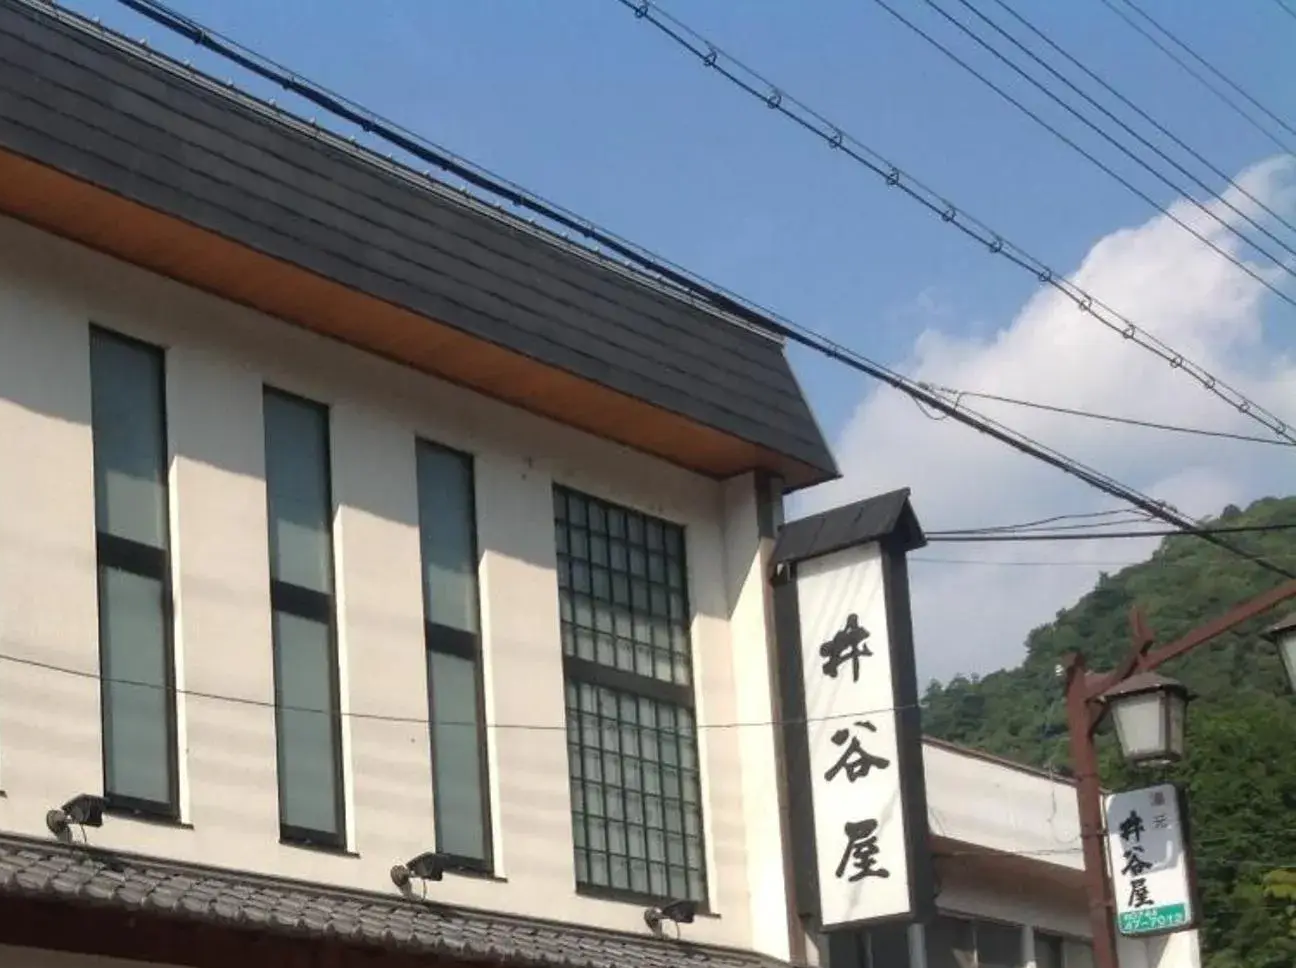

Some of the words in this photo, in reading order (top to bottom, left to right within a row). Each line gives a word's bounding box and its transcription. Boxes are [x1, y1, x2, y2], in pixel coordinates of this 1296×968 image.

[819, 613, 891, 882] 井谷屋
[1119, 809, 1155, 908] 井谷屋
